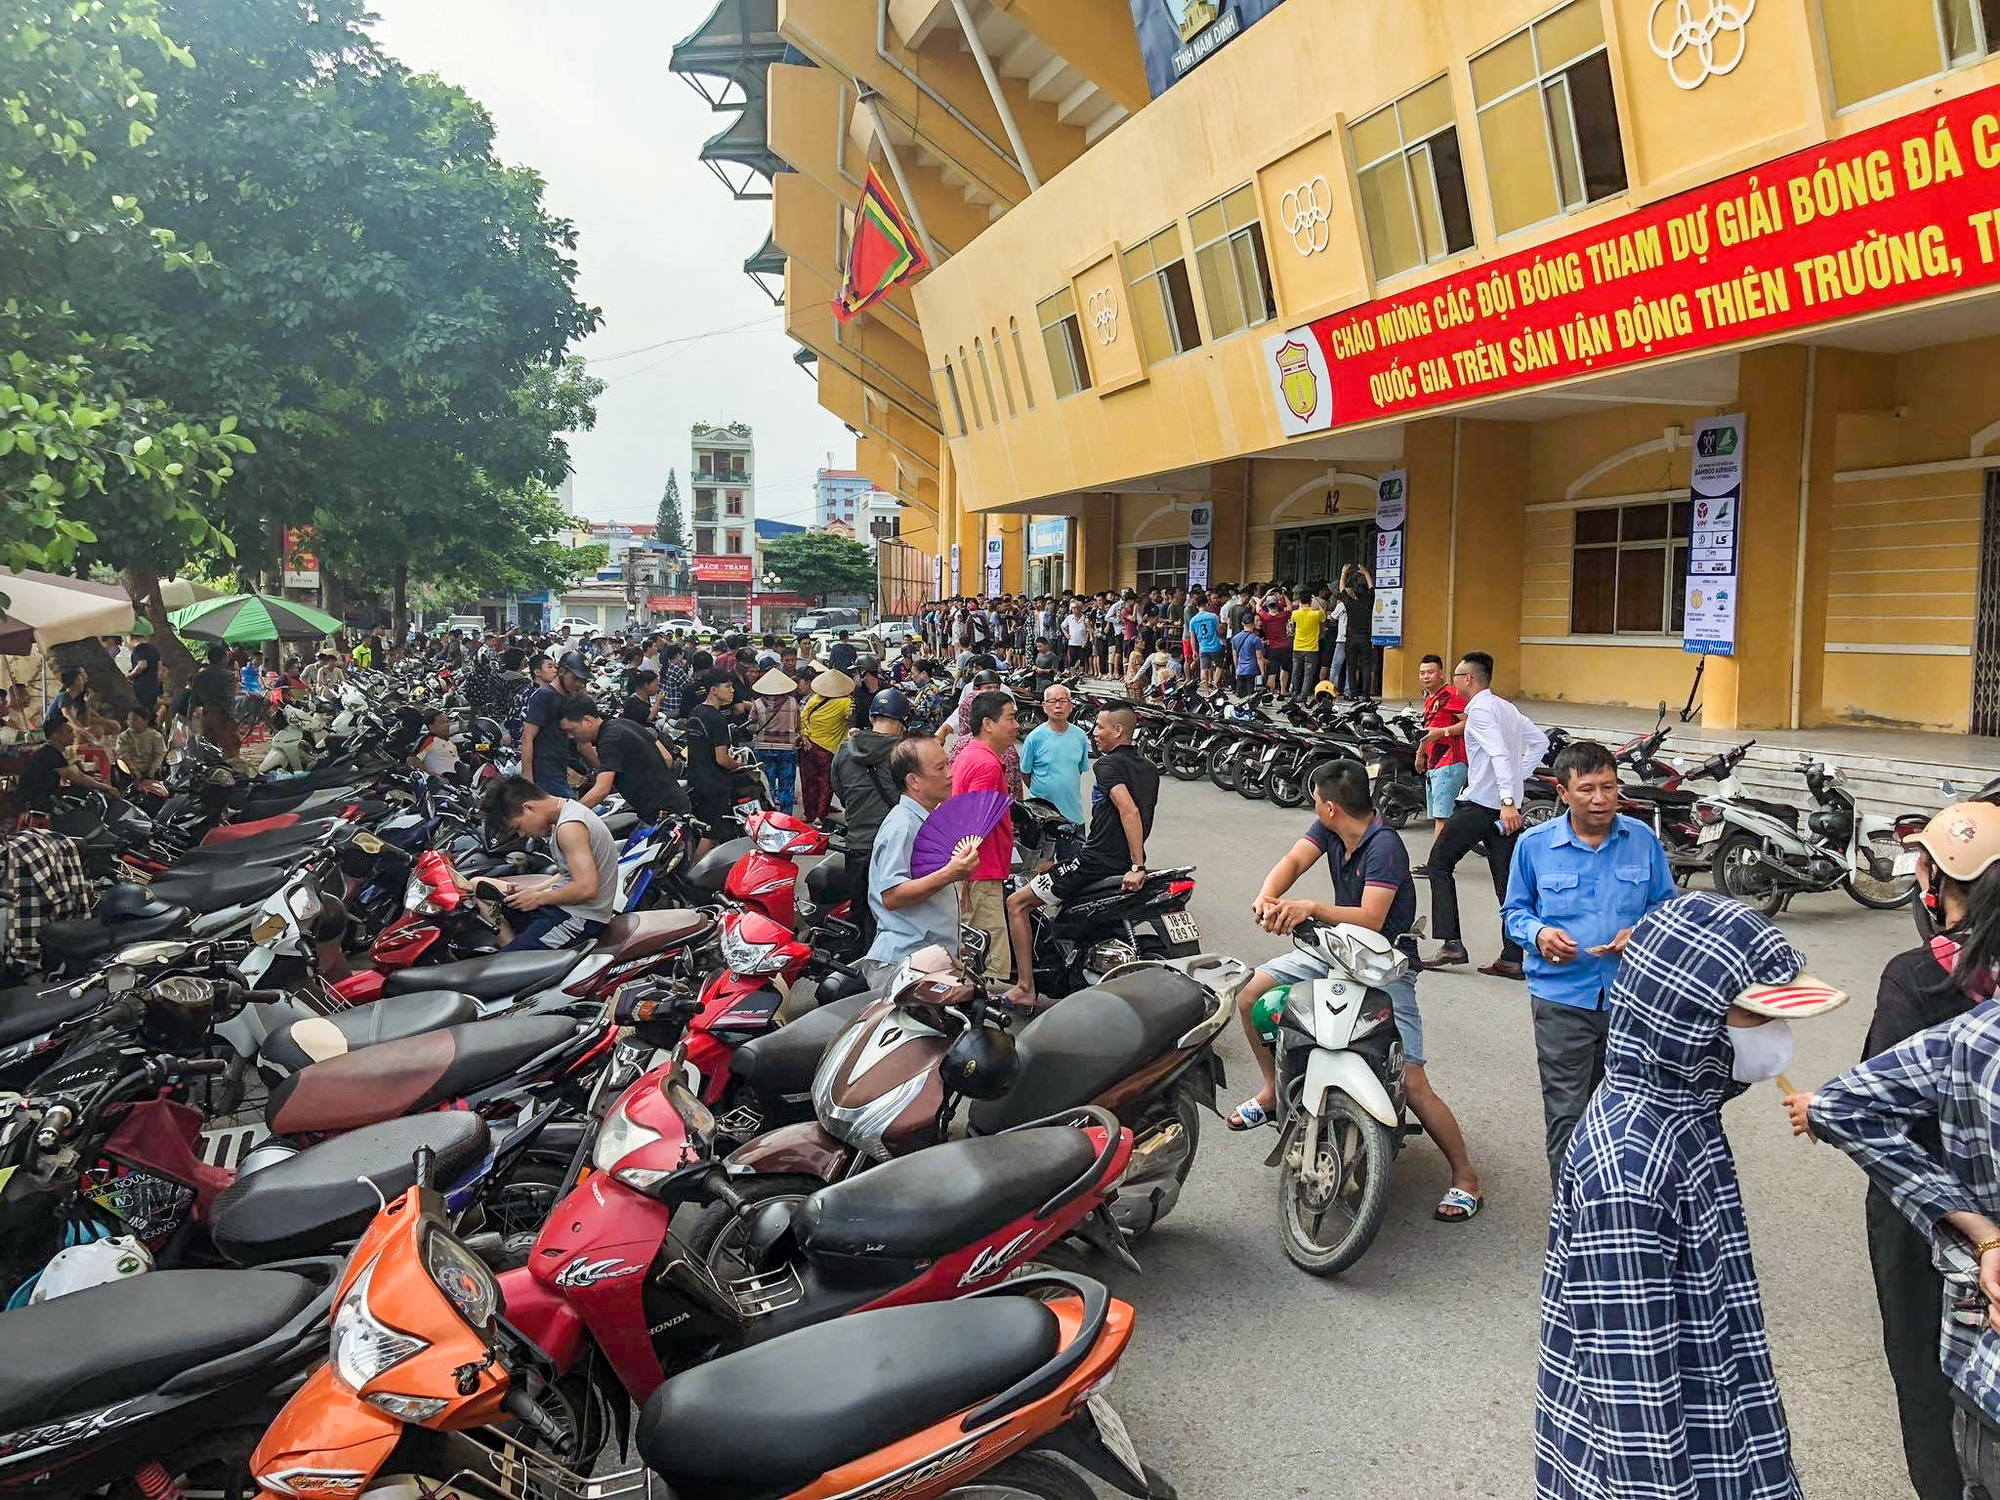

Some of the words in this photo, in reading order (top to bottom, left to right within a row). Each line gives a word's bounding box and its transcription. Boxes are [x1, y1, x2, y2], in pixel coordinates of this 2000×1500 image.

[1194, 33, 1214, 59] NAM
[1331, 317, 1376, 360] CHÀO
[1376, 304, 1432, 347] MỪNG
[1433, 284, 1475, 330] CÁC
[1476, 270, 1516, 320] ĐỘI
[1517, 255, 1584, 306] BÓNG
[1586, 225, 1664, 284] THAM
[1667, 204, 1710, 264] DỰ
[1716, 175, 1783, 247] GIẢI
[1788, 150, 1895, 225] BÓNG
[1902, 116, 1964, 191] ĐÁ
[1369, 357, 1417, 408] QUỐC
[1418, 357, 1453, 394] GIA
[1452, 339, 1508, 386] TRÊN
[1509, 326, 1558, 373] SÂN
[1559, 312, 1613, 366] VẬN
[1615, 296, 1693, 352] ĐỘNG
[1695, 265, 1790, 330] THIÊN
[1794, 225, 1963, 306] TRƯỜNG,
[1324, 490, 1340, 515] A2
[1715, 535, 1727, 545] LS
[1167, 913, 1192, 927] 18-B2
